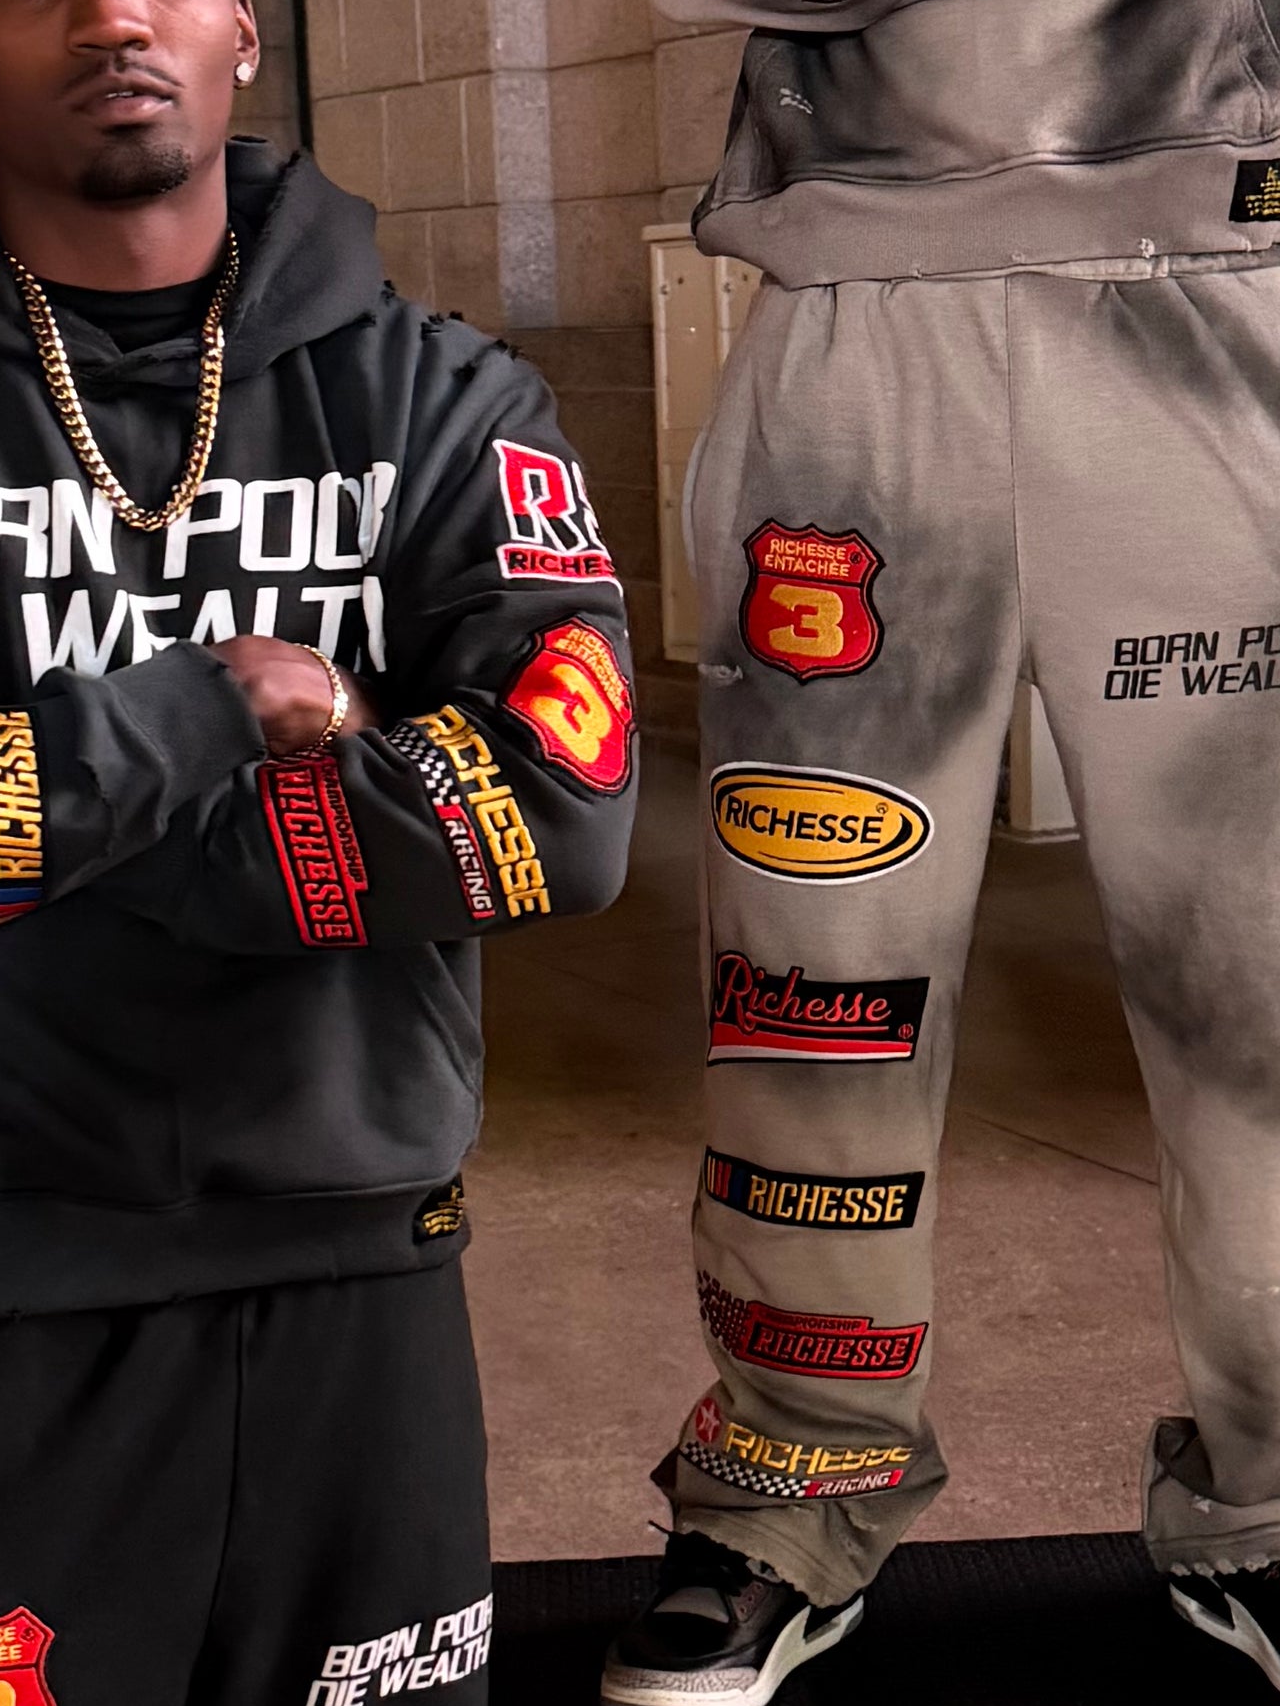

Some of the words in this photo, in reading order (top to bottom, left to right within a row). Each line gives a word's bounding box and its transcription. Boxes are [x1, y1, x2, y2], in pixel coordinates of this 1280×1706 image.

[769, 538, 847, 561] RICHESSE
[768, 583, 844, 658] 3
[1113, 630, 1220, 667] BORN
[1103, 668, 1163, 700] DIE
[529, 662, 613, 764] 3
[411, 704, 552, 918] RICHESSE
[723, 793, 884, 845] RICHESSE
[444, 819, 492, 911] RACING
[715, 953, 892, 1033] Richesse
[748, 1174, 908, 1225] RICHESSE
[725, 1421, 912, 1475] RICHESSE
[816, 1471, 893, 1496] RACING
[320, 1622, 423, 1679] BORN
[379, 1628, 493, 1698] WEALTH
